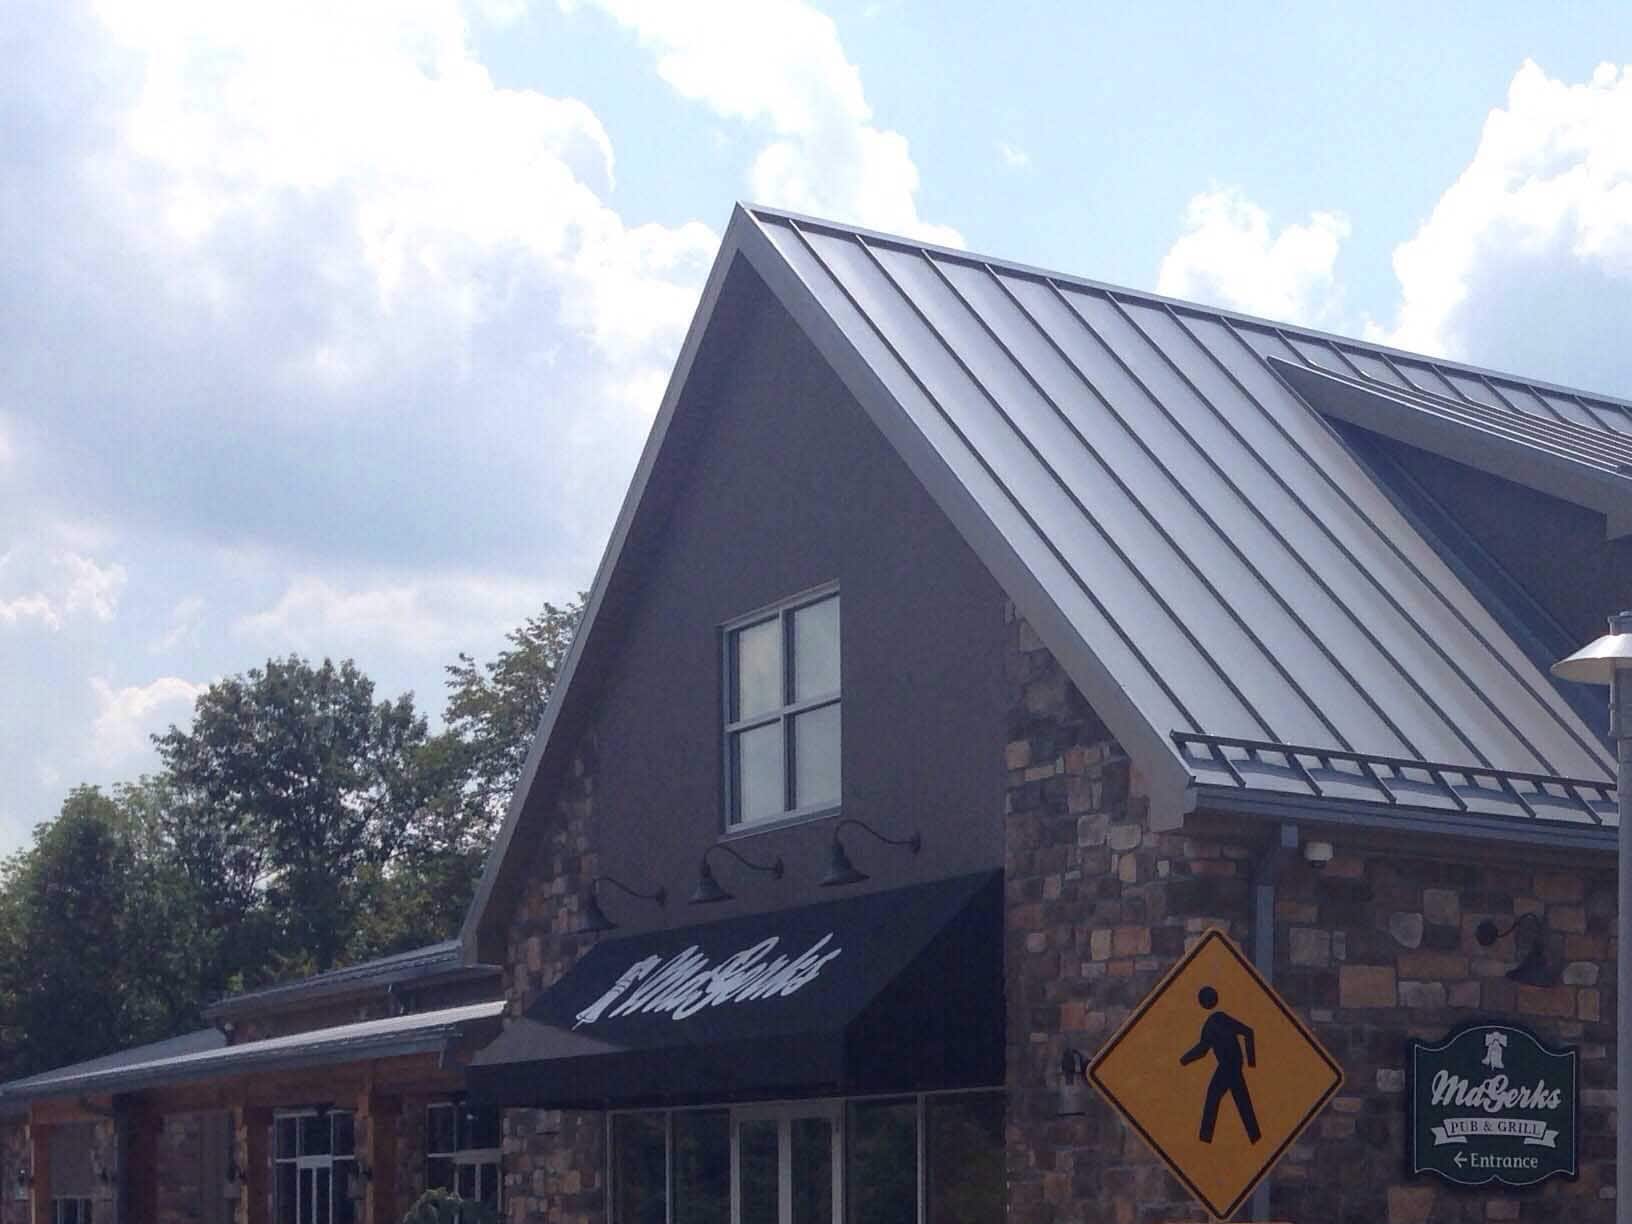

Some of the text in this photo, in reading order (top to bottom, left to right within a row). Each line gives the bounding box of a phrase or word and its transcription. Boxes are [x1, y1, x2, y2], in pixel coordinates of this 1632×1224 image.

[1431, 1069, 1561, 1113] MaGerks
[1450, 1120, 1542, 1136] PUB & GRILL
[1470, 1152, 1539, 1168] Entrance
